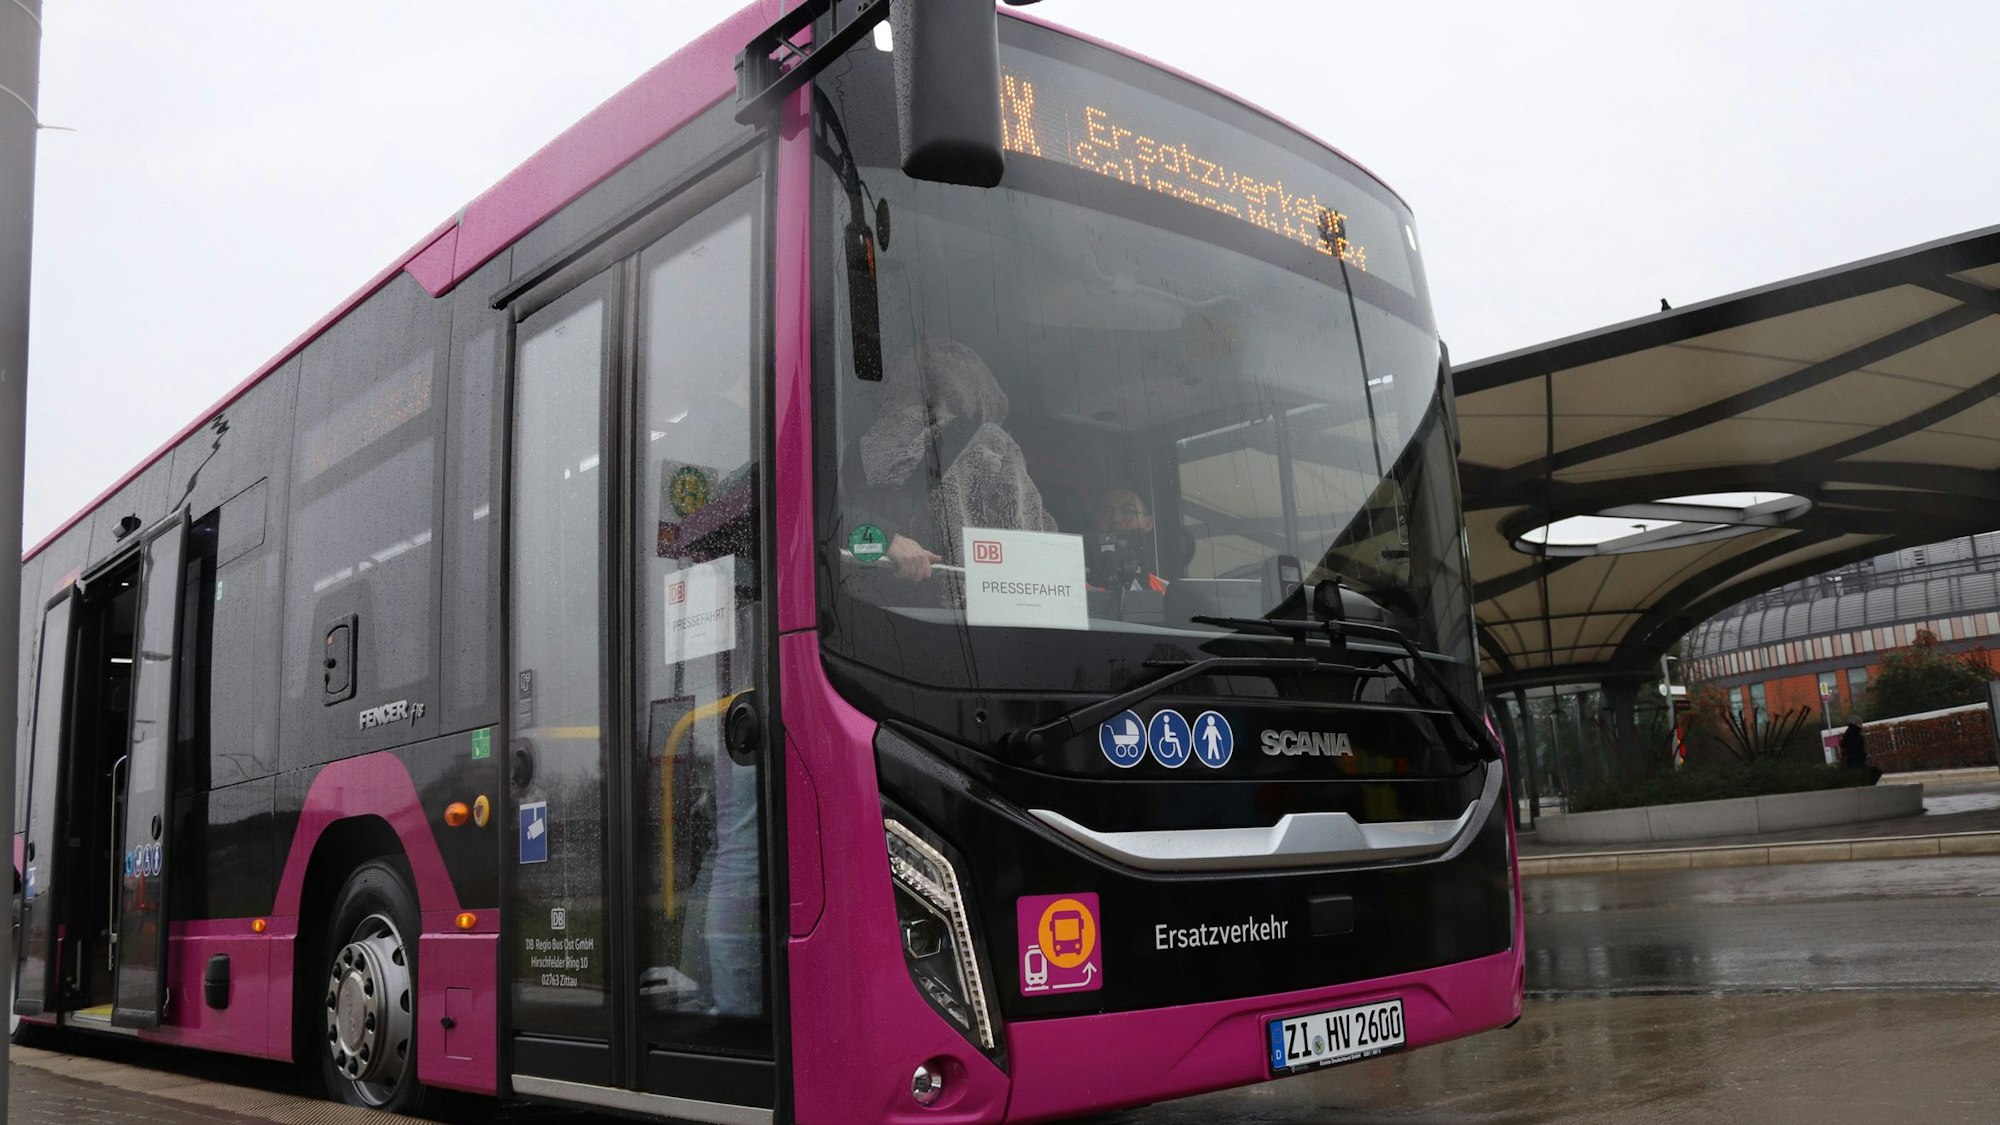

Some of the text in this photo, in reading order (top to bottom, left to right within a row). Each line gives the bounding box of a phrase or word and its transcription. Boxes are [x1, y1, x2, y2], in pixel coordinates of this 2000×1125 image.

[1085, 105, 1348, 233] Ersatzverkehr
[862, 526, 873, 543] 4
[976, 543, 1000, 562] DB
[670, 584, 684, 602] DB
[982, 580, 1072, 598] PRESSEFAHRT
[672, 607, 725, 632] PRESSEFAHRT
[359, 699, 409, 731] FENCER
[1261, 729, 1354, 757] SCANIA
[553, 911, 564, 927] DB
[1155, 914, 1289, 951] Ersatzverkehr
[525, 937, 594, 952] DB Regio Bus Ost GmbH
[531, 956, 588, 971] Hirschfelder Ring 10
[541, 974, 578, 987] 02763 Zittau
[1285, 1005, 1402, 1060] ZI HV 2600
[1276, 1049, 1281, 1060] D
